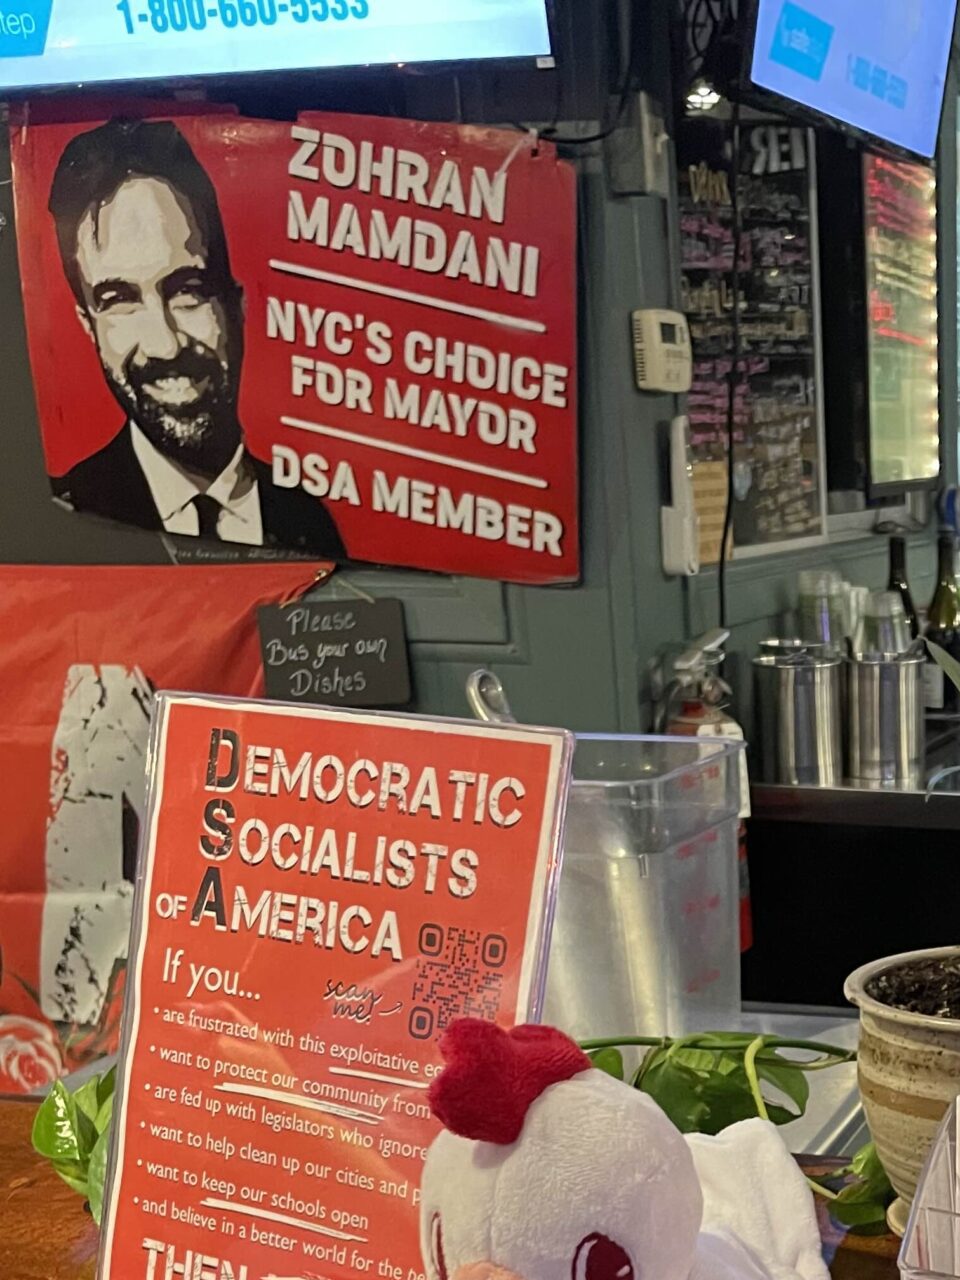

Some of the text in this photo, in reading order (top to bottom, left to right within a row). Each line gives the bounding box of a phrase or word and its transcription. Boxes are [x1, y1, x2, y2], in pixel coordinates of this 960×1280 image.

[0, 11, 36, 35] tep
[288, 124, 508, 224] ZOHRAN
[287, 190, 540, 297] MAMDANI
[266, 296, 569, 408] NYC'S CHOICE
[291, 354, 537, 454] FOR MAYOR
[271, 444, 563, 557] DSA MEMBER
[266, 638, 309, 667] Bus
[312, 642, 350, 669] your
[286, 608, 356, 636] Please
[289, 666, 367, 697] Dishes
[204, 727, 526, 828] DEMOCRATIC
[198, 798, 480, 899] SOCIALISTS
[155, 866, 404, 962] OF AMERICA
[162, 947, 262, 1001] If you...
[322, 978, 385, 1004] scan
[163, 1007, 185, 1025] are
[188, 1013, 258, 1041] frustrated
[263, 1027, 294, 1048] with
[299, 1033, 326, 1056] this
[329, 1041, 419, 1075] exploitative
[159, 1045, 432, 1120] want to protect our community from
[149, 1123, 183, 1144] want
[187, 1129, 203, 1149] to
[205, 1132, 236, 1160] help
[239, 1142, 278, 1167] clean
[281, 1154, 301, 1176] up
[304, 1158, 333, 1180] our
[335, 1164, 375, 1192] cities
[378, 1172, 409, 1199] and
[154, 1083, 428, 1162] are fed up with legislators who ignore
[146, 1161, 370, 1231] want to keep our schools open
[142, 1196, 167, 1218] and
[170, 1200, 217, 1232] believe
[220, 1215, 235, 1237] in
[238, 1222, 247, 1240] a
[250, 1222, 298, 1252] better
[302, 1238, 348, 1266] world
[350, 1249, 375, 1275] for
